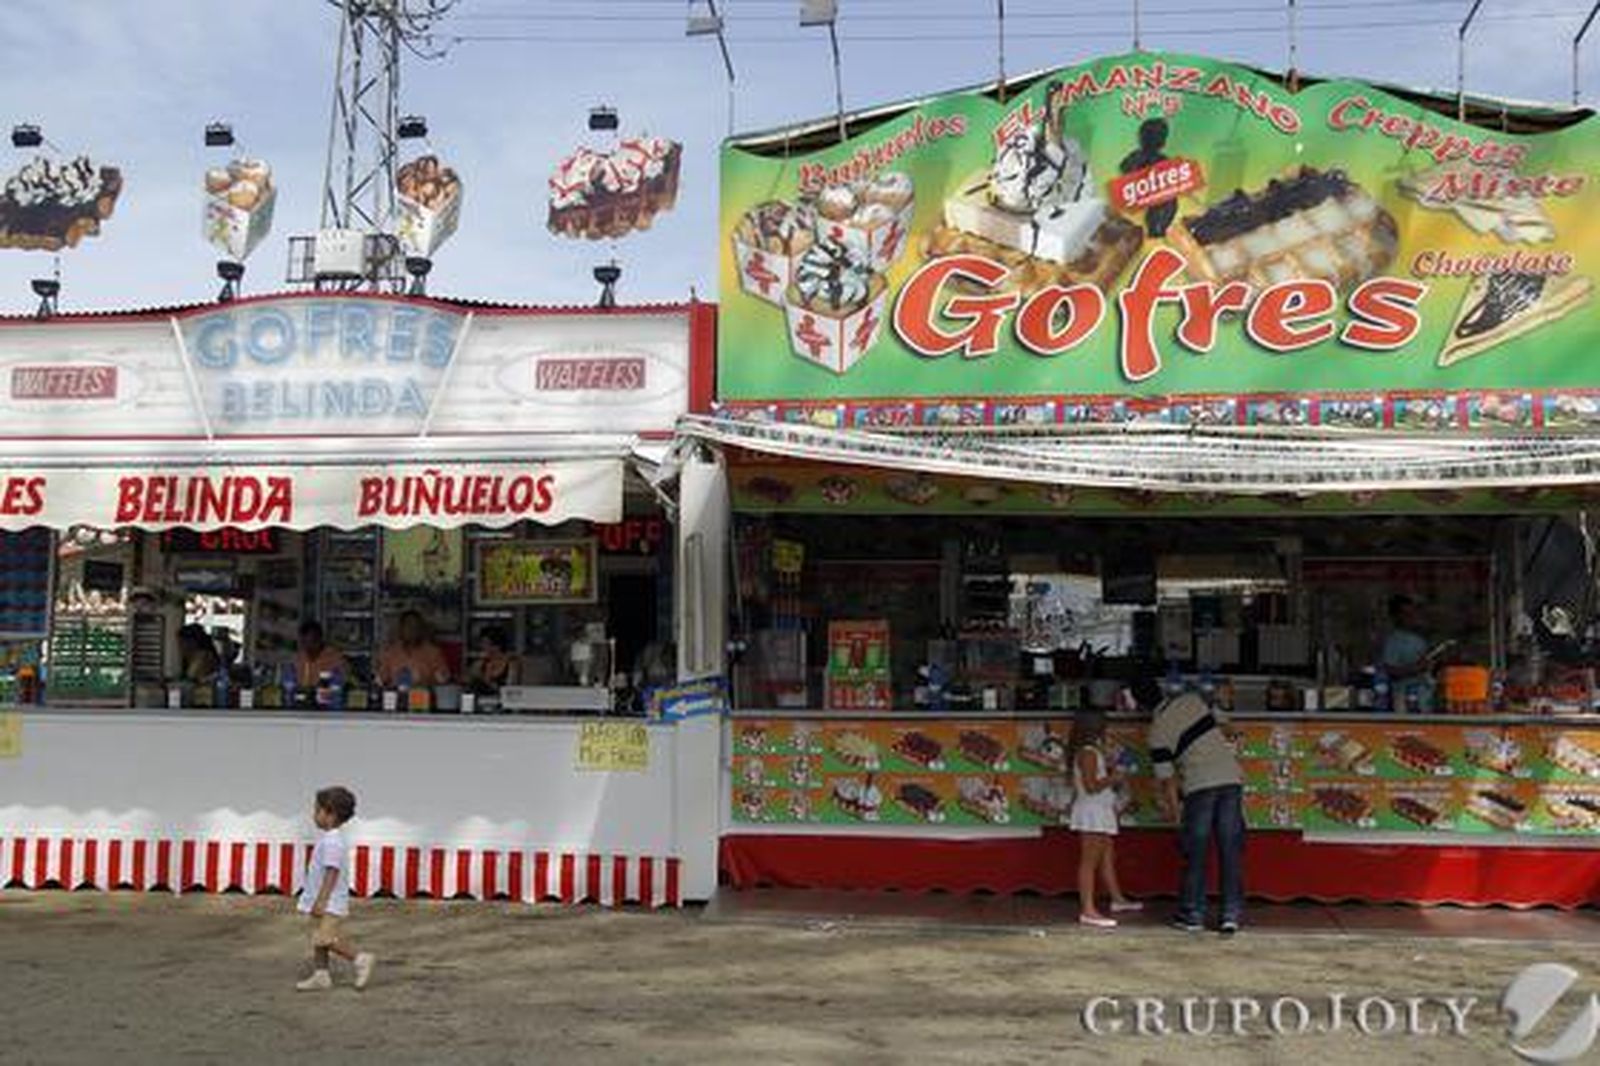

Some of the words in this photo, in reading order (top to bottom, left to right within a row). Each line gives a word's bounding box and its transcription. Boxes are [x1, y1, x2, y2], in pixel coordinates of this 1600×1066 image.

[1058, 62, 1303, 134] MANZANO
[1326, 95, 1531, 170] Creppes
[1121, 161, 1192, 207] gofres
[1411, 248, 1578, 278] Chocolate
[194, 301, 457, 369] GOFRES
[893, 250, 1429, 382] Gofres
[12, 368, 106, 397] WAFFLES
[220, 377, 426, 422] BELINDA
[538, 360, 645, 389] WAFFLES
[114, 476, 293, 523] BELINDA
[358, 469, 555, 516] BUÑUELOS
